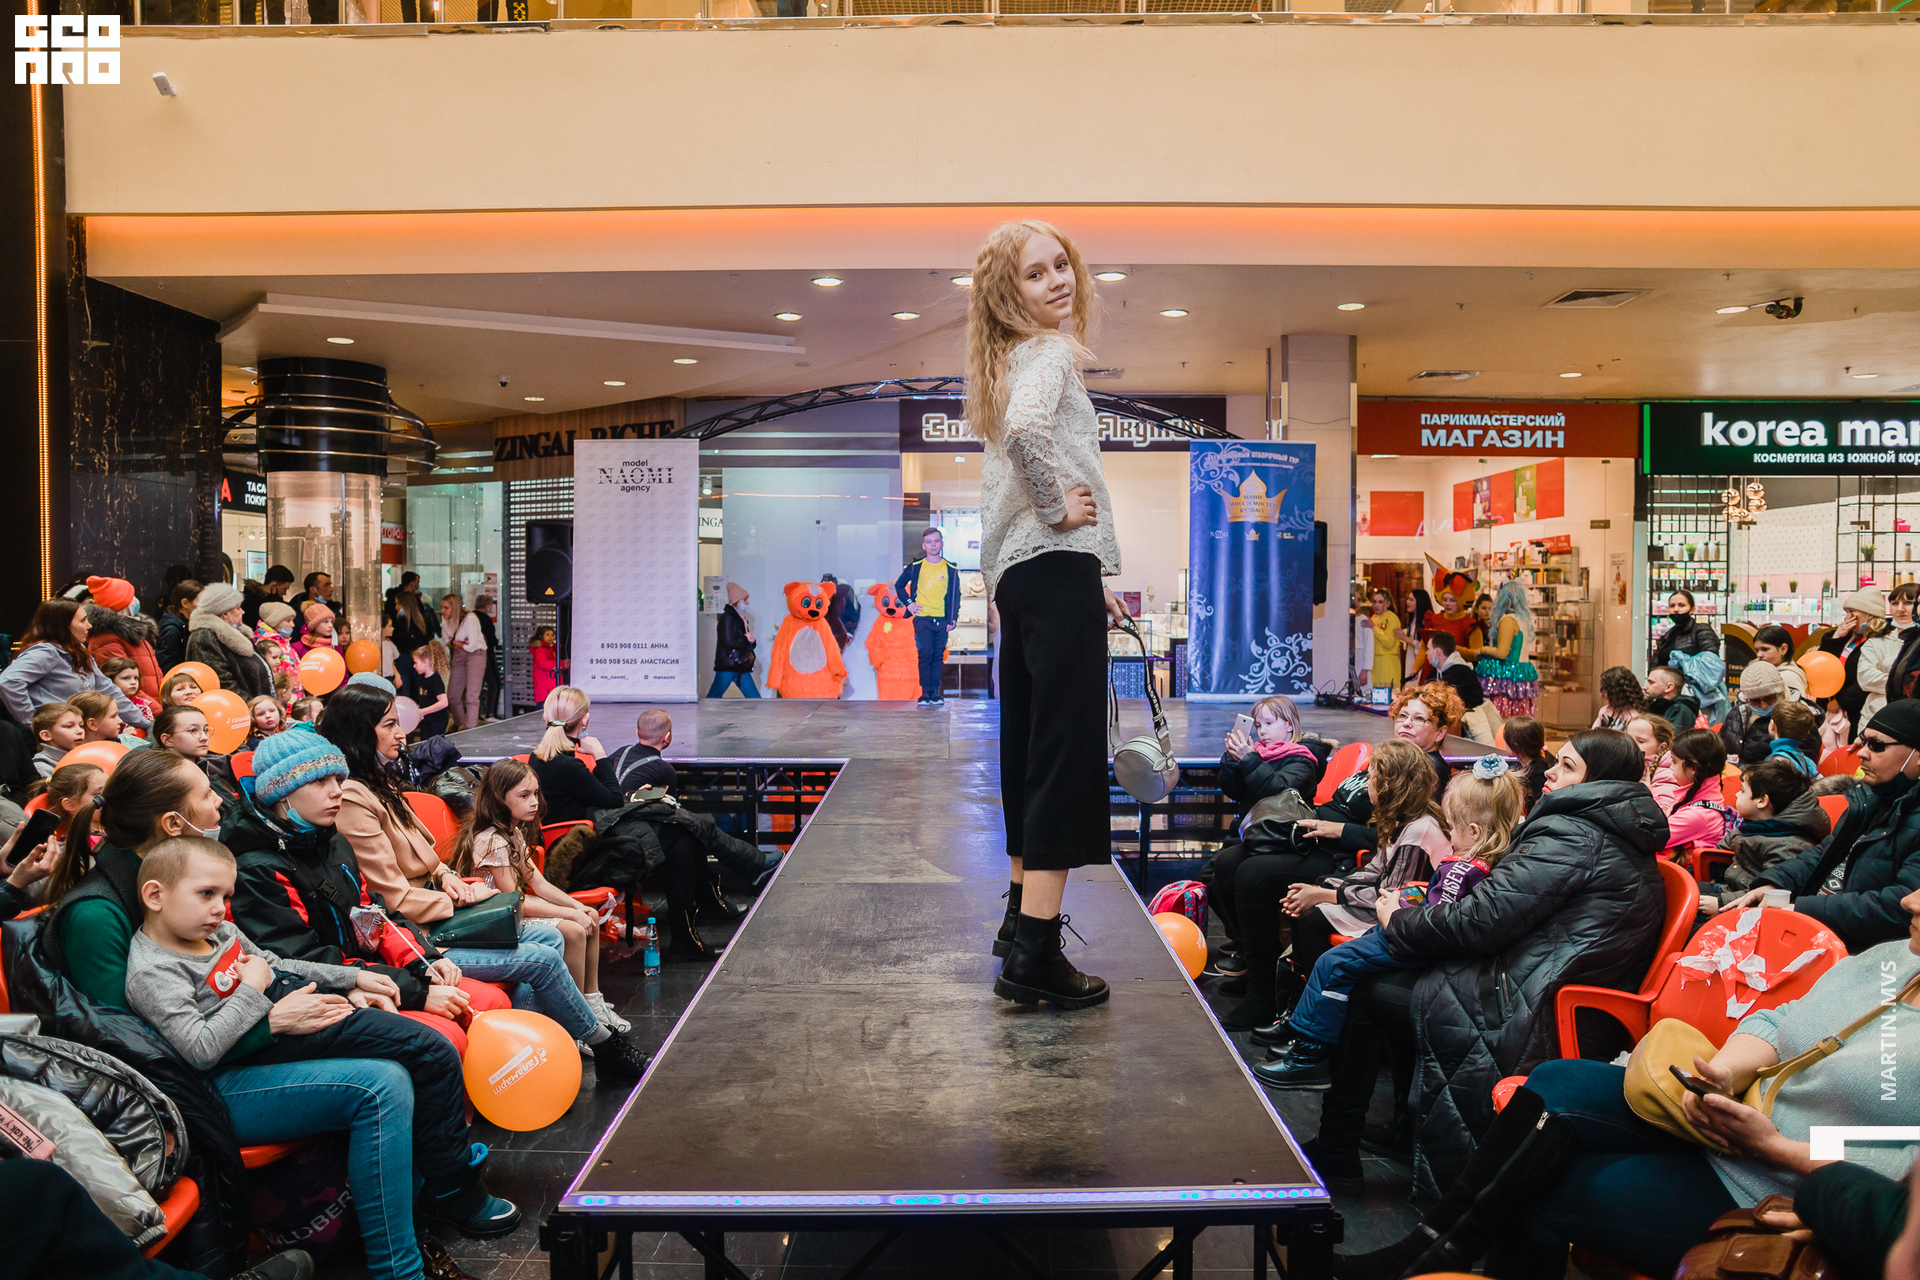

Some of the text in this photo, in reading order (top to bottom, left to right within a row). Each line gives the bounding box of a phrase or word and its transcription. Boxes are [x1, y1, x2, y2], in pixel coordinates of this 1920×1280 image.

[1420, 412, 1566, 427] ПАРИКМАСТЕРСКИЙ
[1701, 411, 1829, 446] korea
[1420, 428, 1566, 449] МАГАЗИН
[622, 459, 649, 467] model
[1753, 452, 1826, 464] косметика
[1828, 453, 1845, 463] из
[1848, 450, 1896, 464] южной
[597, 467, 675, 485] NAOMI
[620, 484, 651, 493] agency
[492, 1055, 540, 1095] Галамарт
